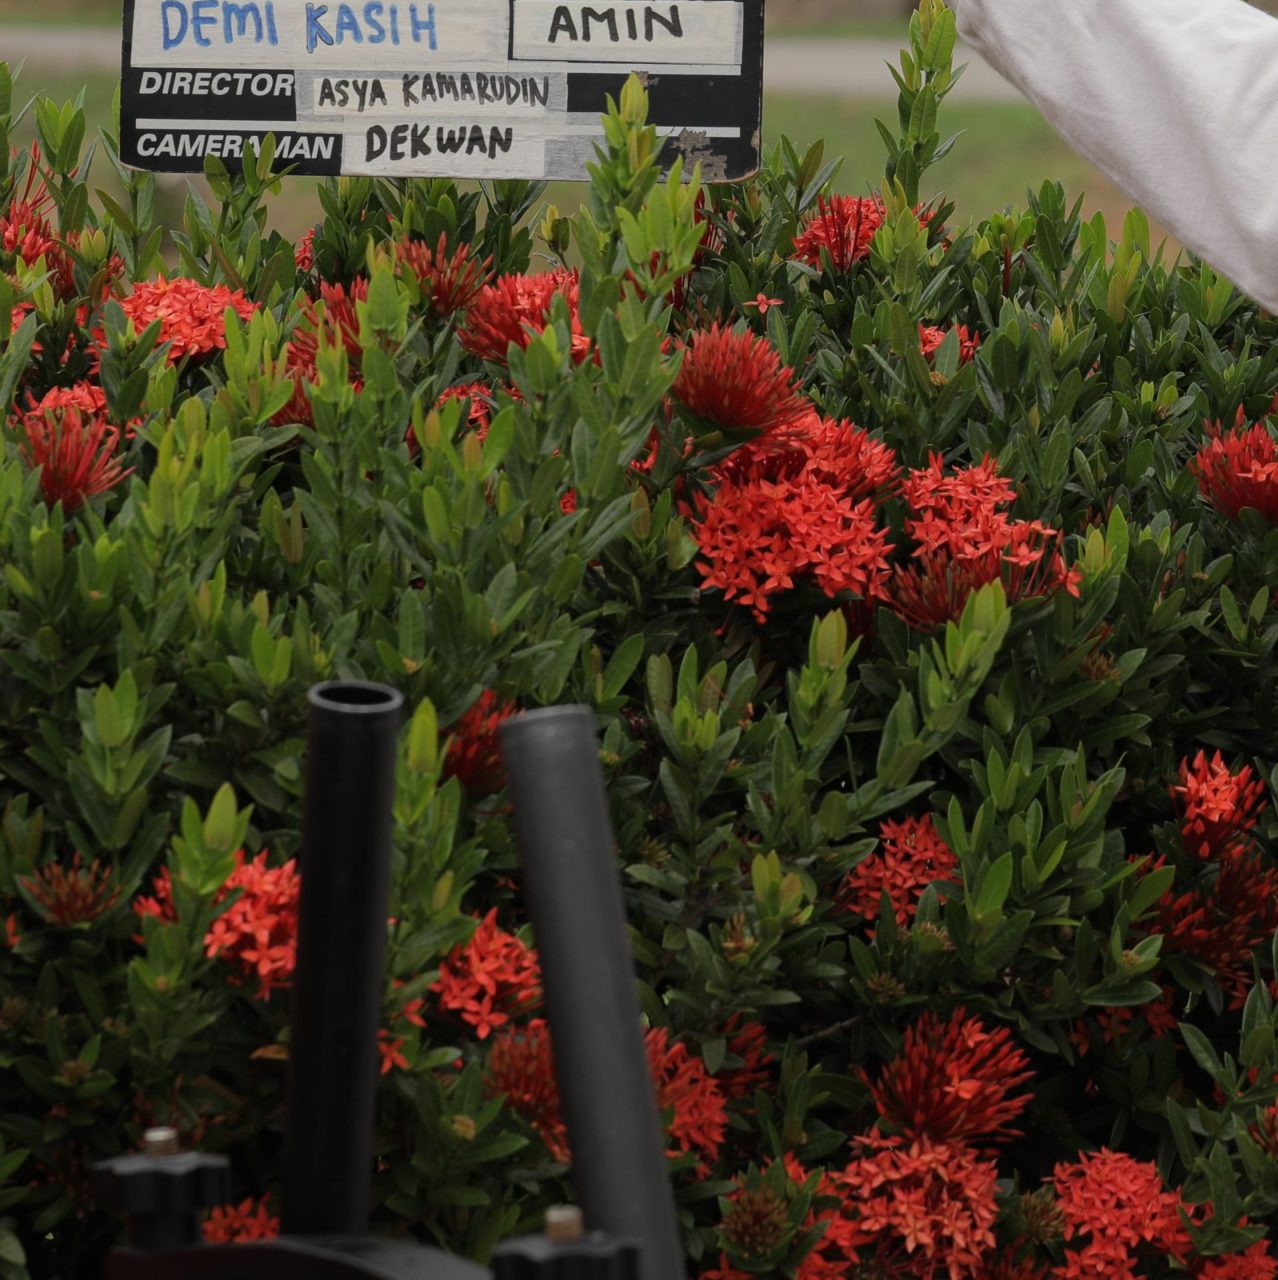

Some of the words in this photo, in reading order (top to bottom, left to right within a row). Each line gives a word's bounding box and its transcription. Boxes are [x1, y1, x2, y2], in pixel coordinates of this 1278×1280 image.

[161, 0, 278, 50] DEMI
[305, 0, 438, 54] KASIH
[548, 5, 683, 43] AMIN
[138, 72, 296, 96] DIRECTOR
[318, 78, 388, 112] ASYA
[402, 72, 549, 107] KAMARUDIN
[365, 123, 513, 163] DEKWAN
